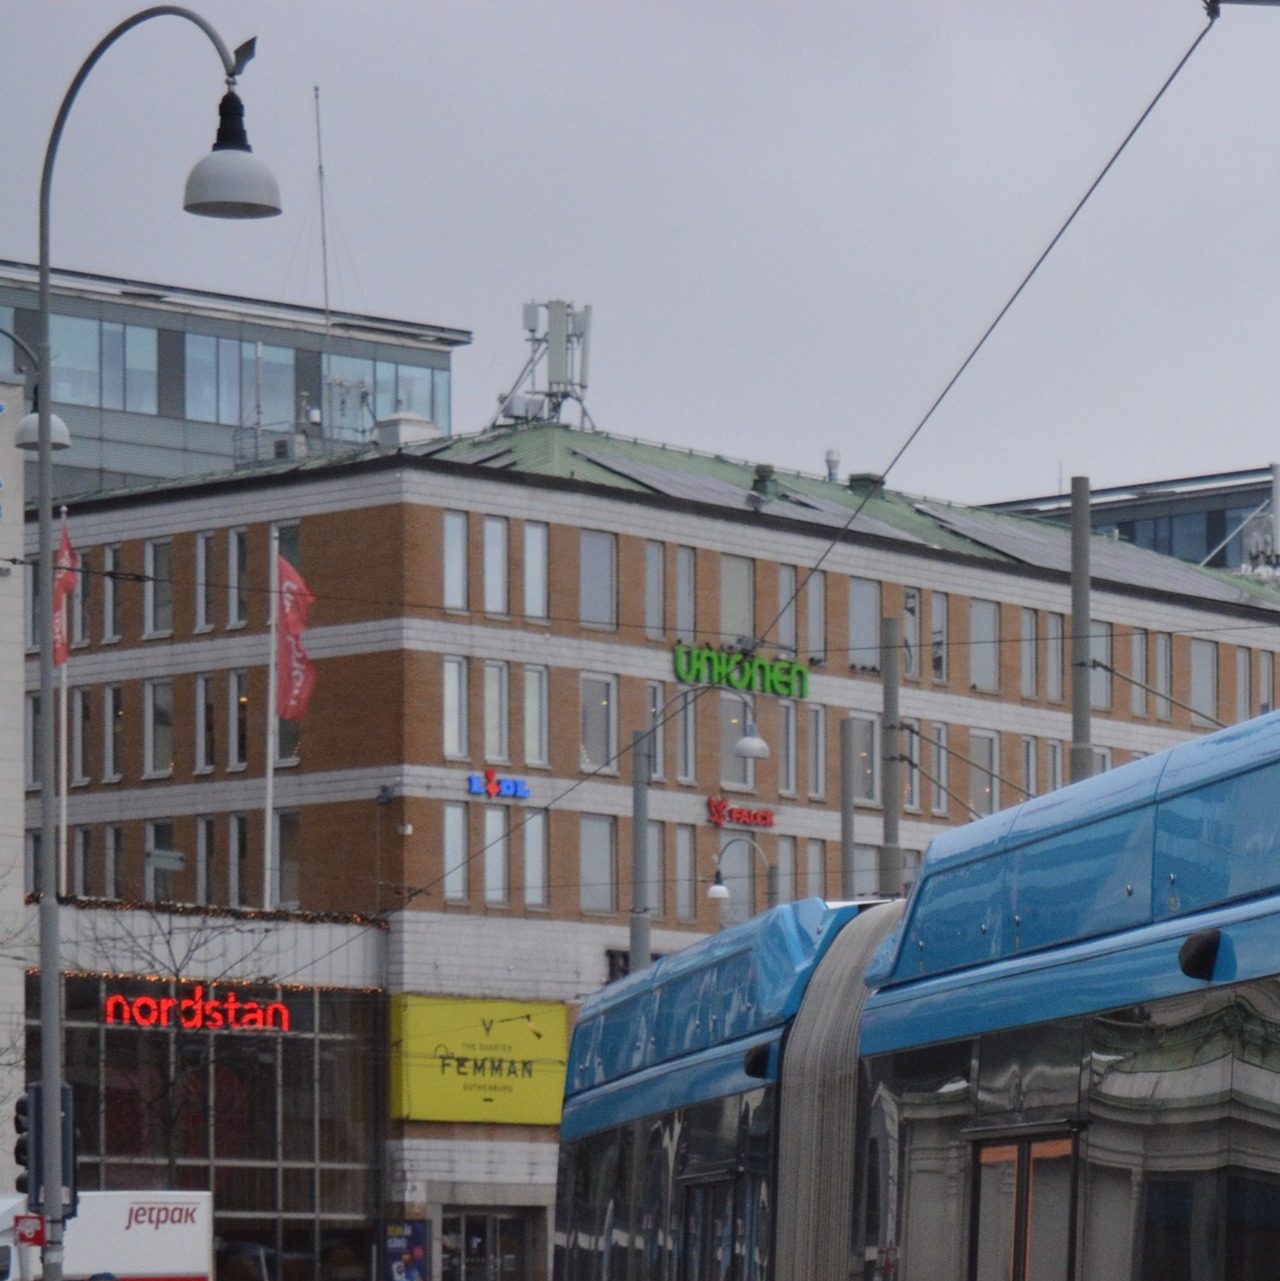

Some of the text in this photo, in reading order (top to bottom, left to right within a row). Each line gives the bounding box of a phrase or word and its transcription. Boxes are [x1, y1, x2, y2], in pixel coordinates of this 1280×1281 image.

[106, 986, 290, 1032] nordstan
[440, 1056, 533, 1078] FEMMAN
[125, 1205, 196, 1230] jetpak
